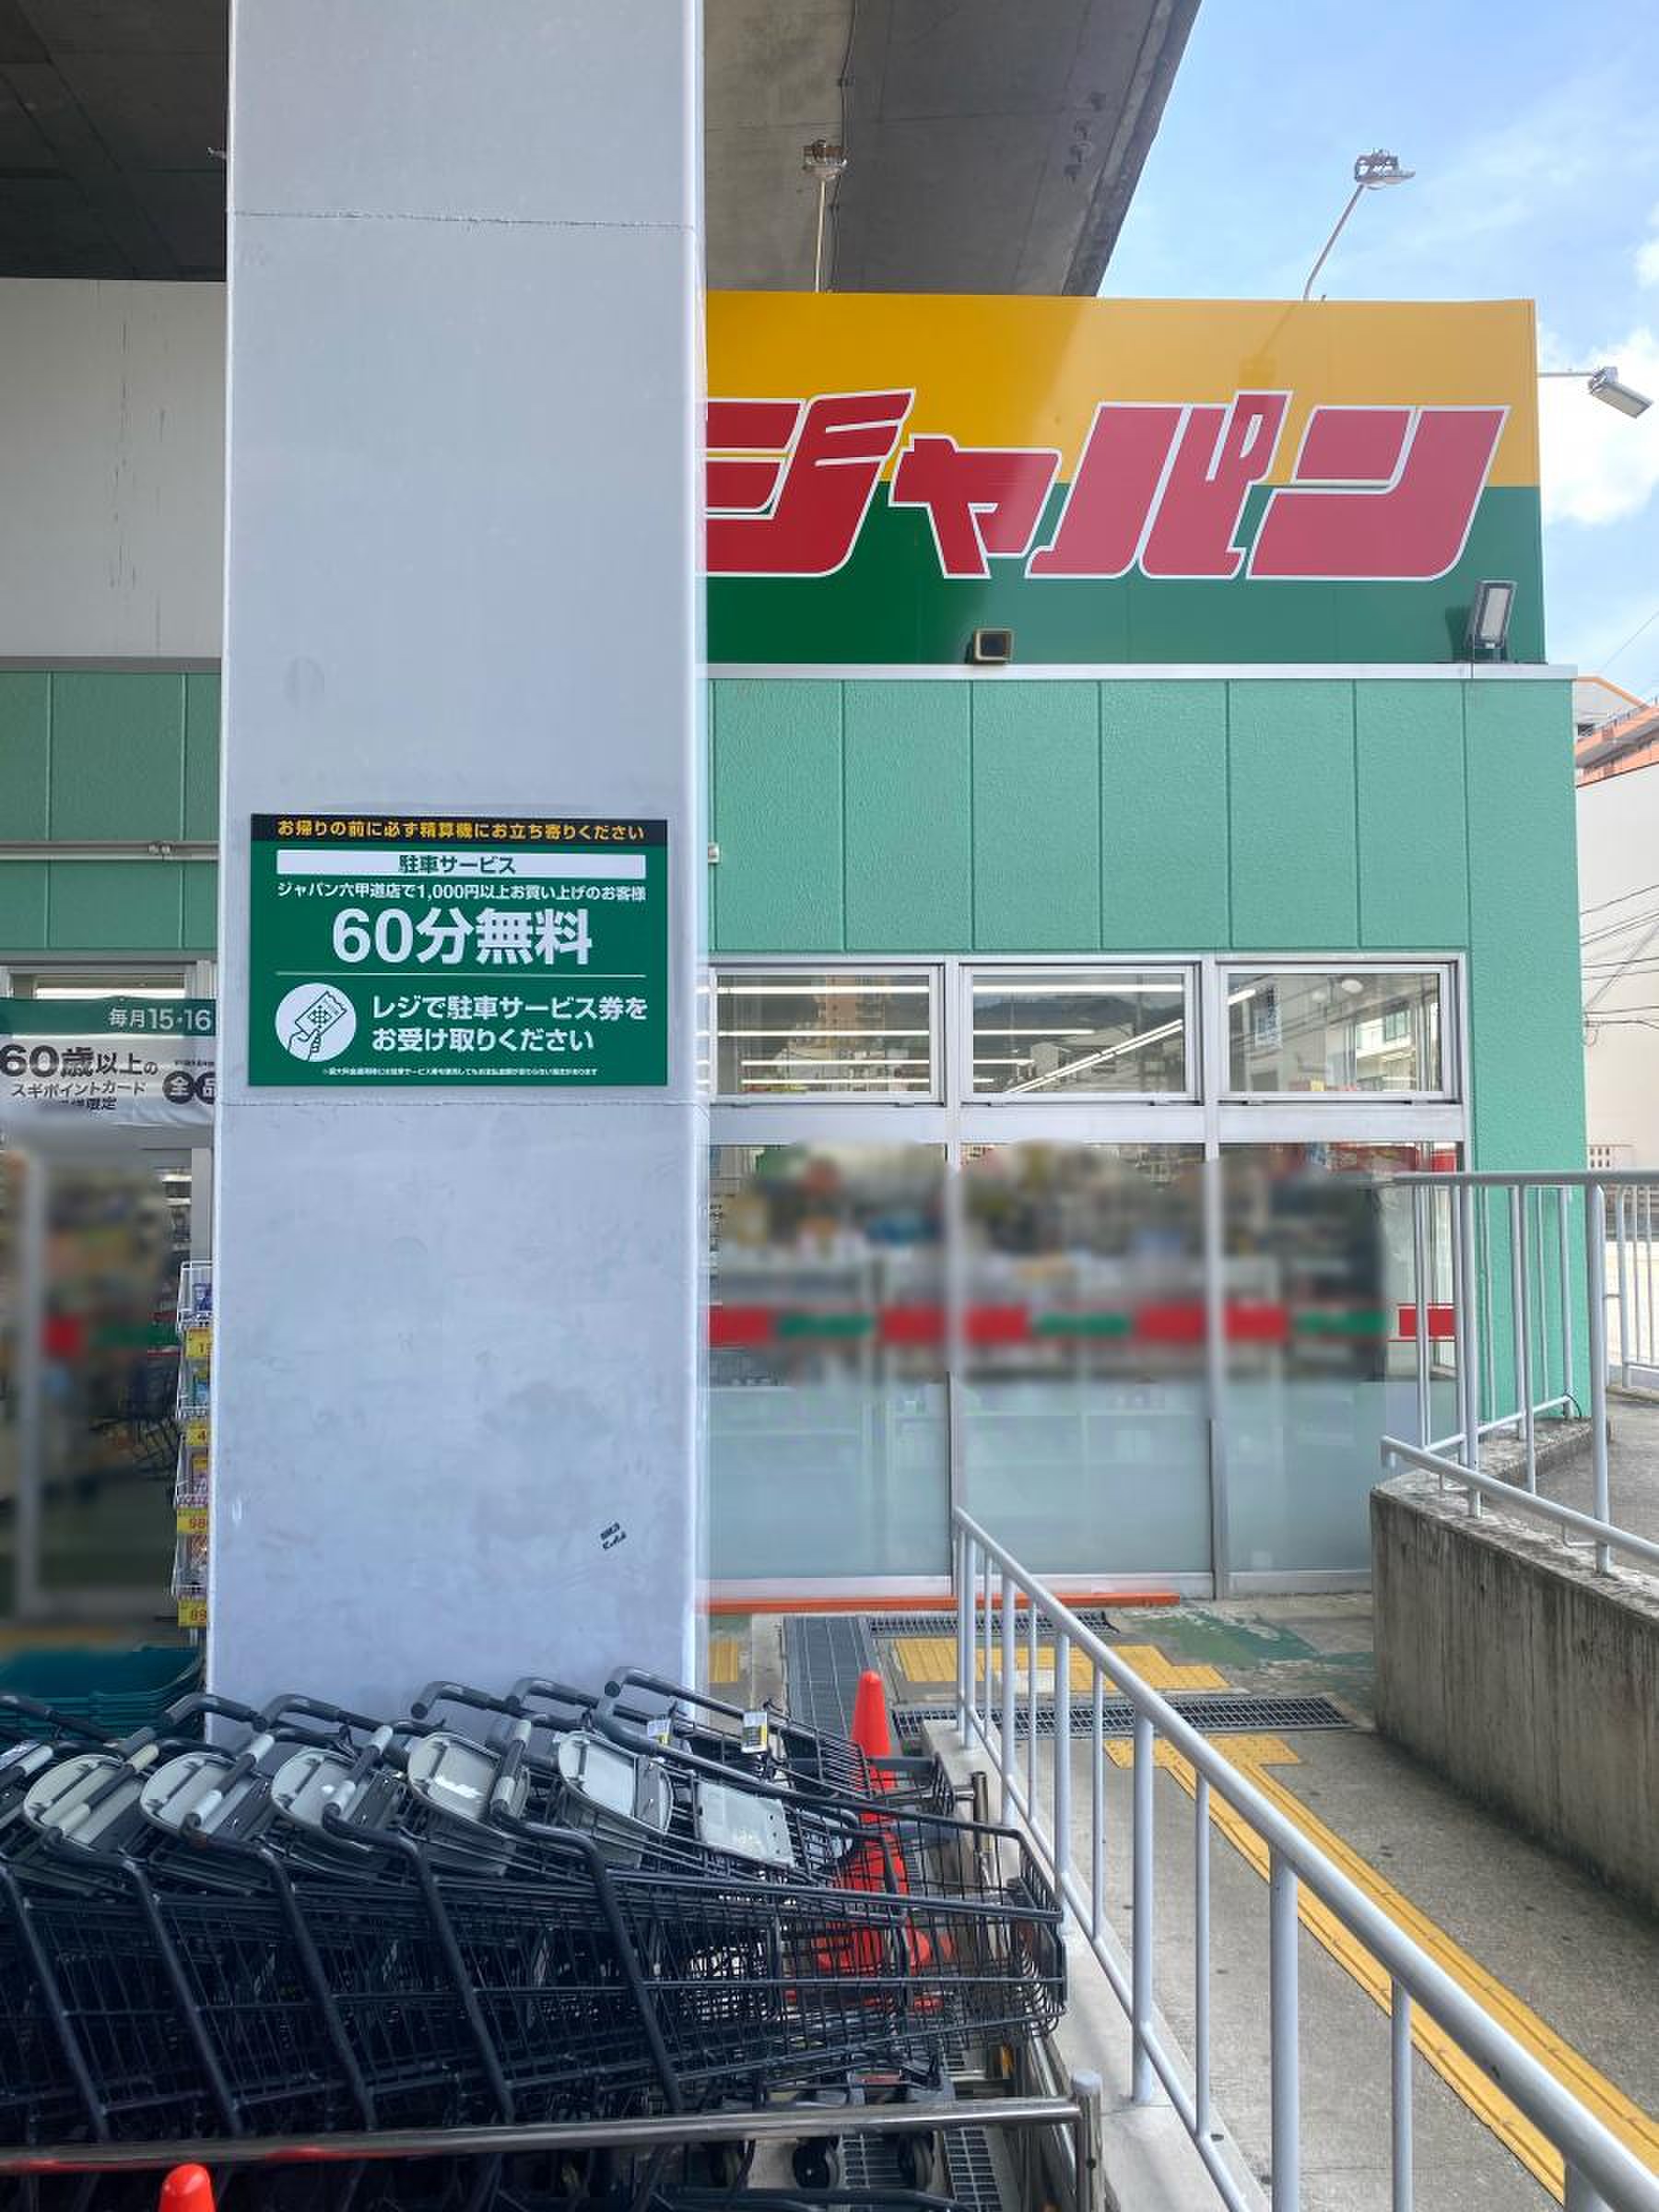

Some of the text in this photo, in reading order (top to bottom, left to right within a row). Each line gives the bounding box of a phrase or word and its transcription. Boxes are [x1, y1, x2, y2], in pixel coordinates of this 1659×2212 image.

[277, 819, 644, 841] お帰りの前に必ず精算機にお立ち寄りください
[398, 854, 516, 875] 駐車サービス
[277, 882, 646, 901] ジャパン六甲道店で1,000円以上お買い上げのお客様
[332, 907, 593, 965] 60分無料
[372, 995, 648, 1021] レジで駐車サービス券を
[371, 1028, 594, 1052] お受け取りください
[0, 1043, 159, 1077] 60歳以上の
[12, 1079, 146, 1099] スギポイントカード
